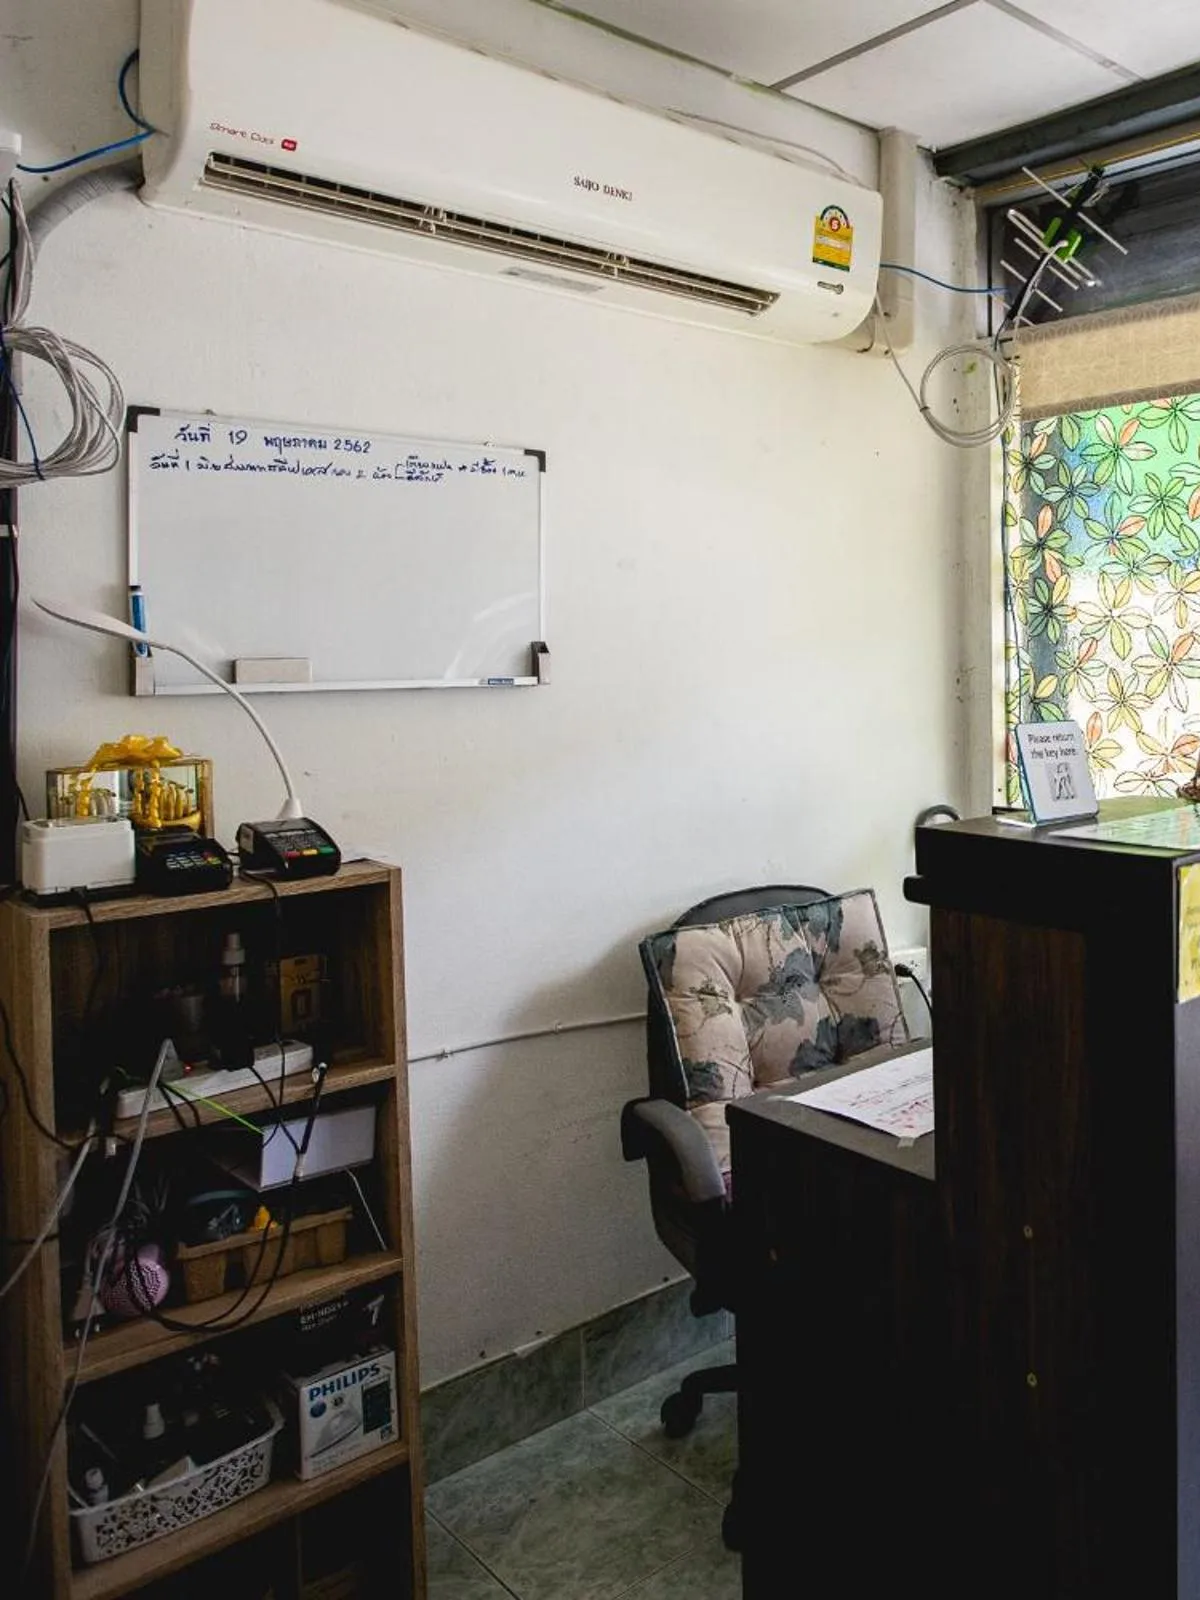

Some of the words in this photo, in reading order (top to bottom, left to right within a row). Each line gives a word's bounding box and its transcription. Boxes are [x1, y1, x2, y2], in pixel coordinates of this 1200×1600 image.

[174, 423, 211, 443] วันที่
[228, 429, 249, 446] 19
[263, 435, 328, 456] พฤษภาคม
[333, 438, 372, 454] 2562
[1044, 747, 1059, 760] key
[308, 1362, 381, 1403] PHILIPS
